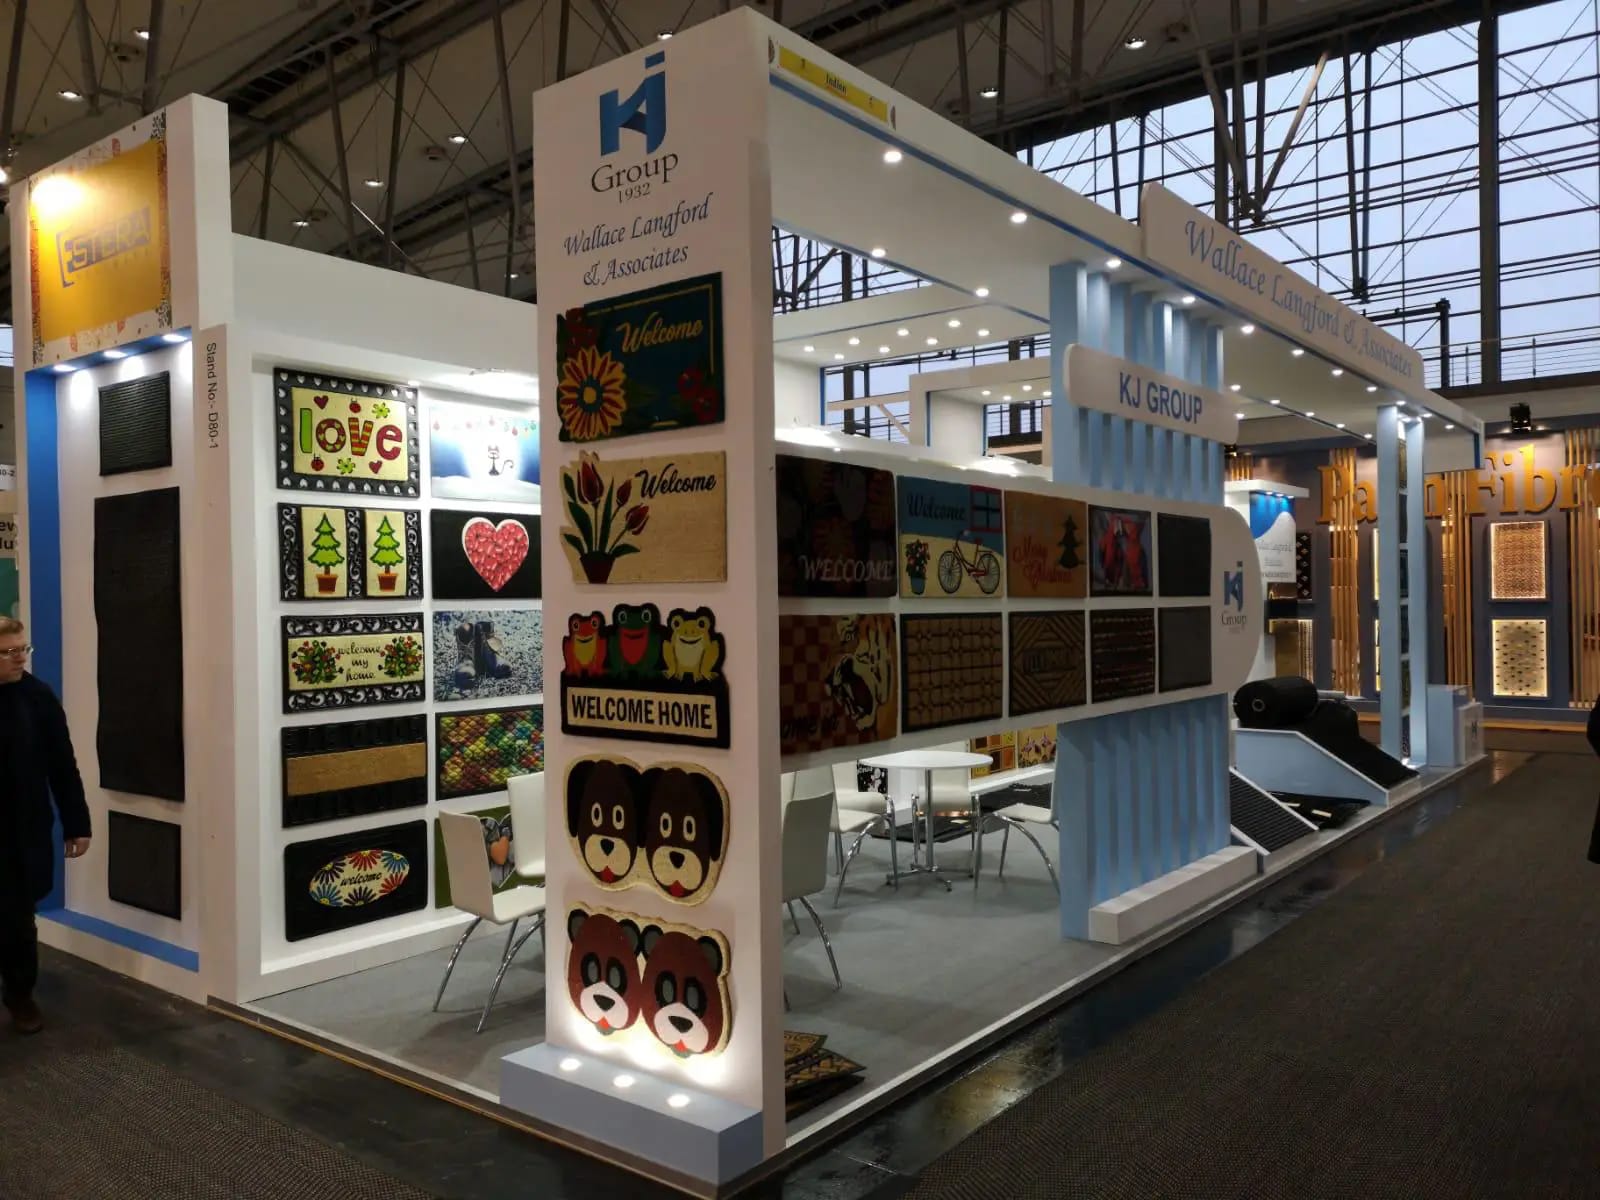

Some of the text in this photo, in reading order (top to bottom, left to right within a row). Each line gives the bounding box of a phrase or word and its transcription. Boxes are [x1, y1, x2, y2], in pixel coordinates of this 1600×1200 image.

[591, 152, 679, 193] Group
[617, 183, 651, 203] 1932
[563, 192, 713, 256] Wallace Langford
[602, 245, 688, 285] Associates
[1184, 220, 1266, 295] Wallace
[1271, 274, 1340, 334] Langford
[1356, 328, 1412, 379] Associates
[615, 311, 704, 353] Welcome
[206, 342, 217, 379] Stand
[1119, 372, 1203, 424] KJ GROUP
[208, 412, 219, 449] D80-1
[299, 407, 403, 461] love
[634, 463, 717, 499] Welcome
[1464, 443, 1600, 517] Fibr
[908, 493, 966, 521] Welcome
[799, 555, 896, 583] WELCOME
[1221, 611, 1247, 629] Group
[337, 642, 382, 655] welcome
[351, 658, 369, 669] my
[345, 671, 376, 682] home
[571, 694, 713, 730] WELCOME HOME
[340, 872, 382, 887] welcome
